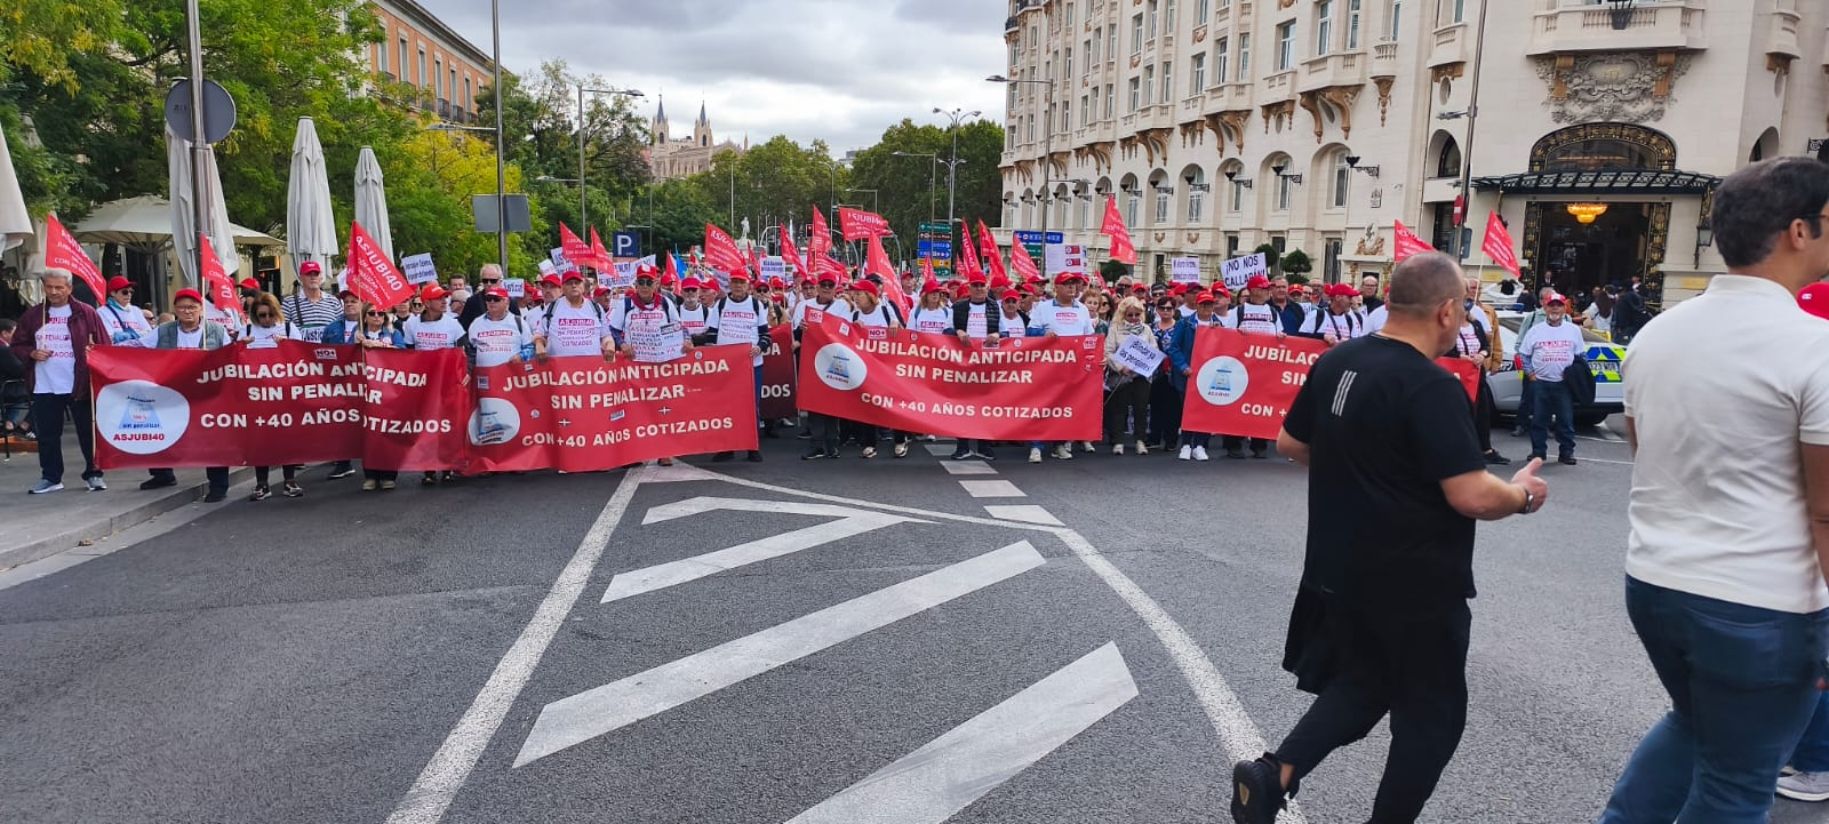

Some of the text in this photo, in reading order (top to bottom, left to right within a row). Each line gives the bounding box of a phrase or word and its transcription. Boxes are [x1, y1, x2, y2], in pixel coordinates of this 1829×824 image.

[617, 235, 632, 255] P
[1226, 256, 1259, 275] ¡NO NOS
[855, 338, 1076, 364] JUBILACIÓN ANTICIPADA
[196, 359, 427, 387] JUBILACIÓN ANTCIPADA
[503, 367, 617, 392] JUBILACIÓN
[620, 359, 729, 381] ANTICIPADA
[896, 364, 1033, 384] SIN PENALIZAR
[248, 383, 382, 404] SIN PENALIR
[551, 384, 685, 410] SIN PENALIZAR
[760, 384, 791, 398] DOS
[861, 392, 1073, 419] CON +40 AÑOS COTIZADOS
[1241, 403, 1273, 417] CON
[201, 408, 451, 434] CON +40 AÑOS TIZADOS
[522, 417, 733, 448] CON +40 AÑOS COTIZADOS
